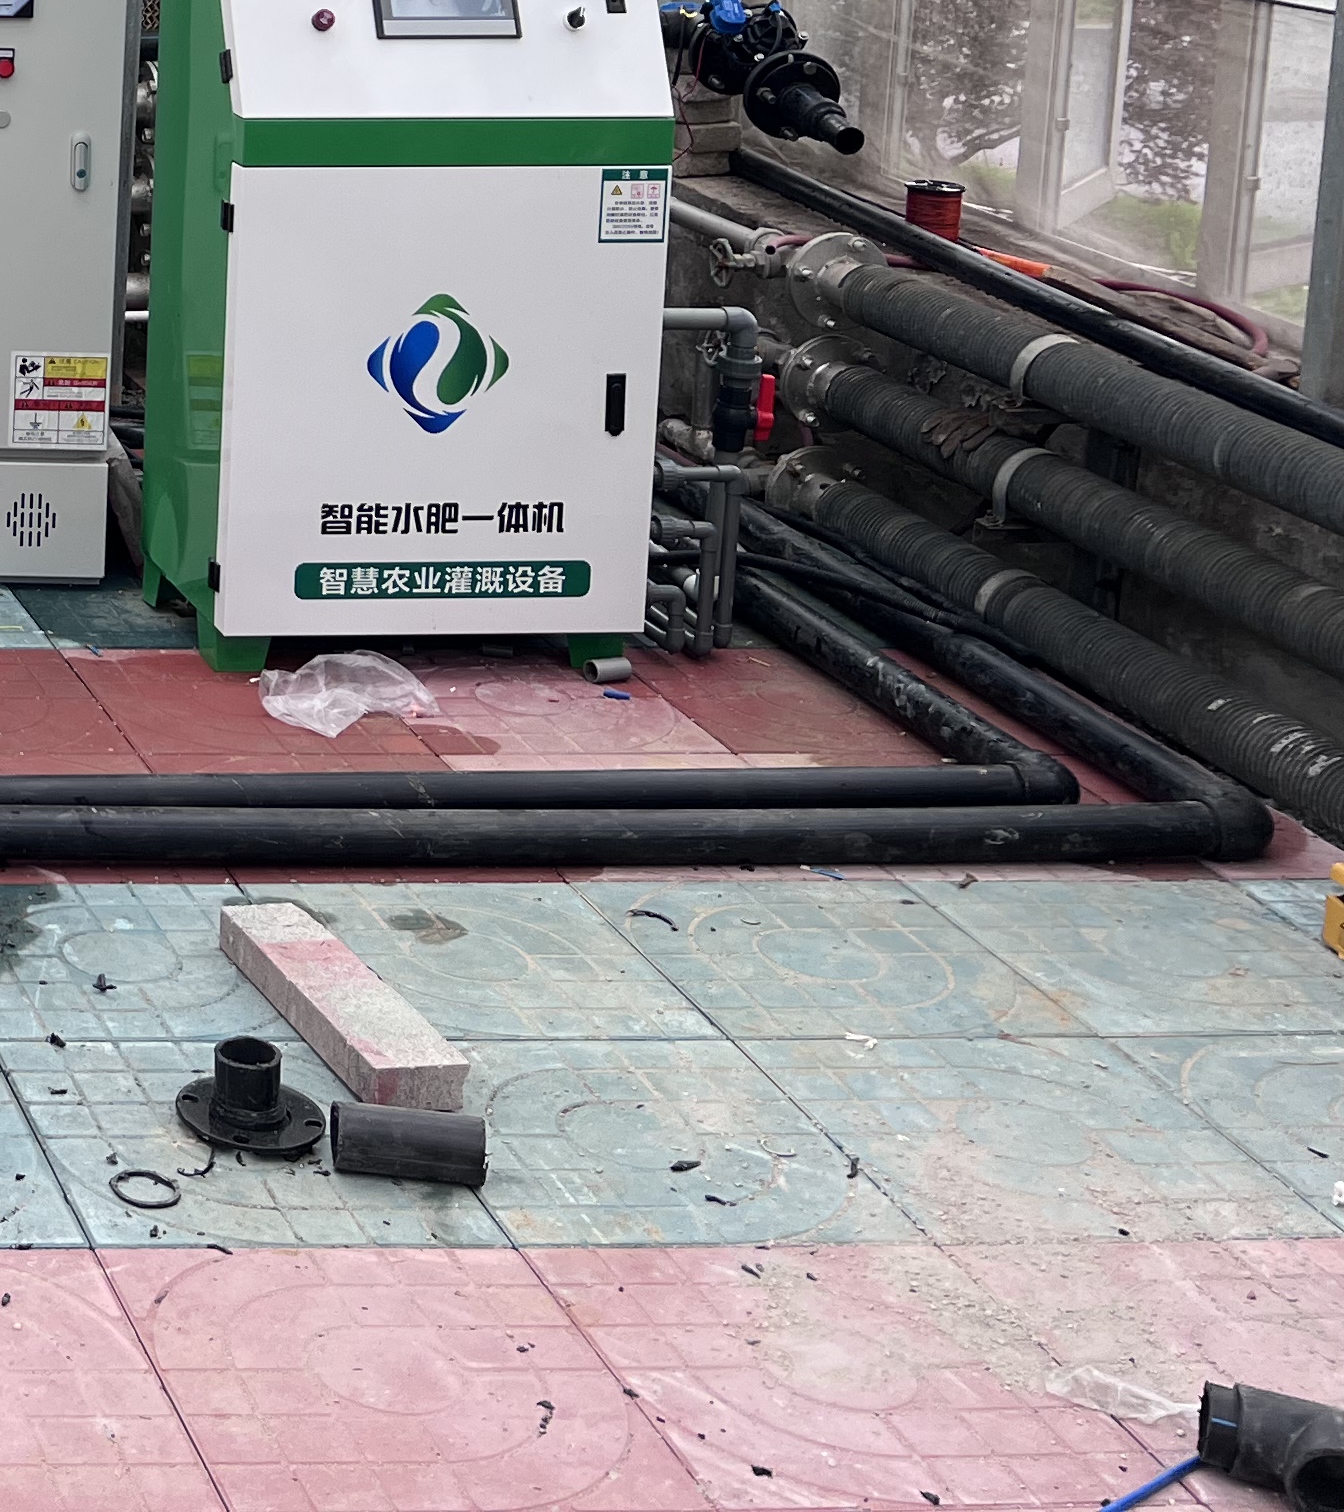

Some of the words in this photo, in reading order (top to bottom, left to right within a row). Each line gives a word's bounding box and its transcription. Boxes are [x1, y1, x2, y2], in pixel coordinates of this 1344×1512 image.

[320, 501, 565, 535] 智能水肥一体机
[319, 565, 566, 596] 智慧农业灌溉设备
